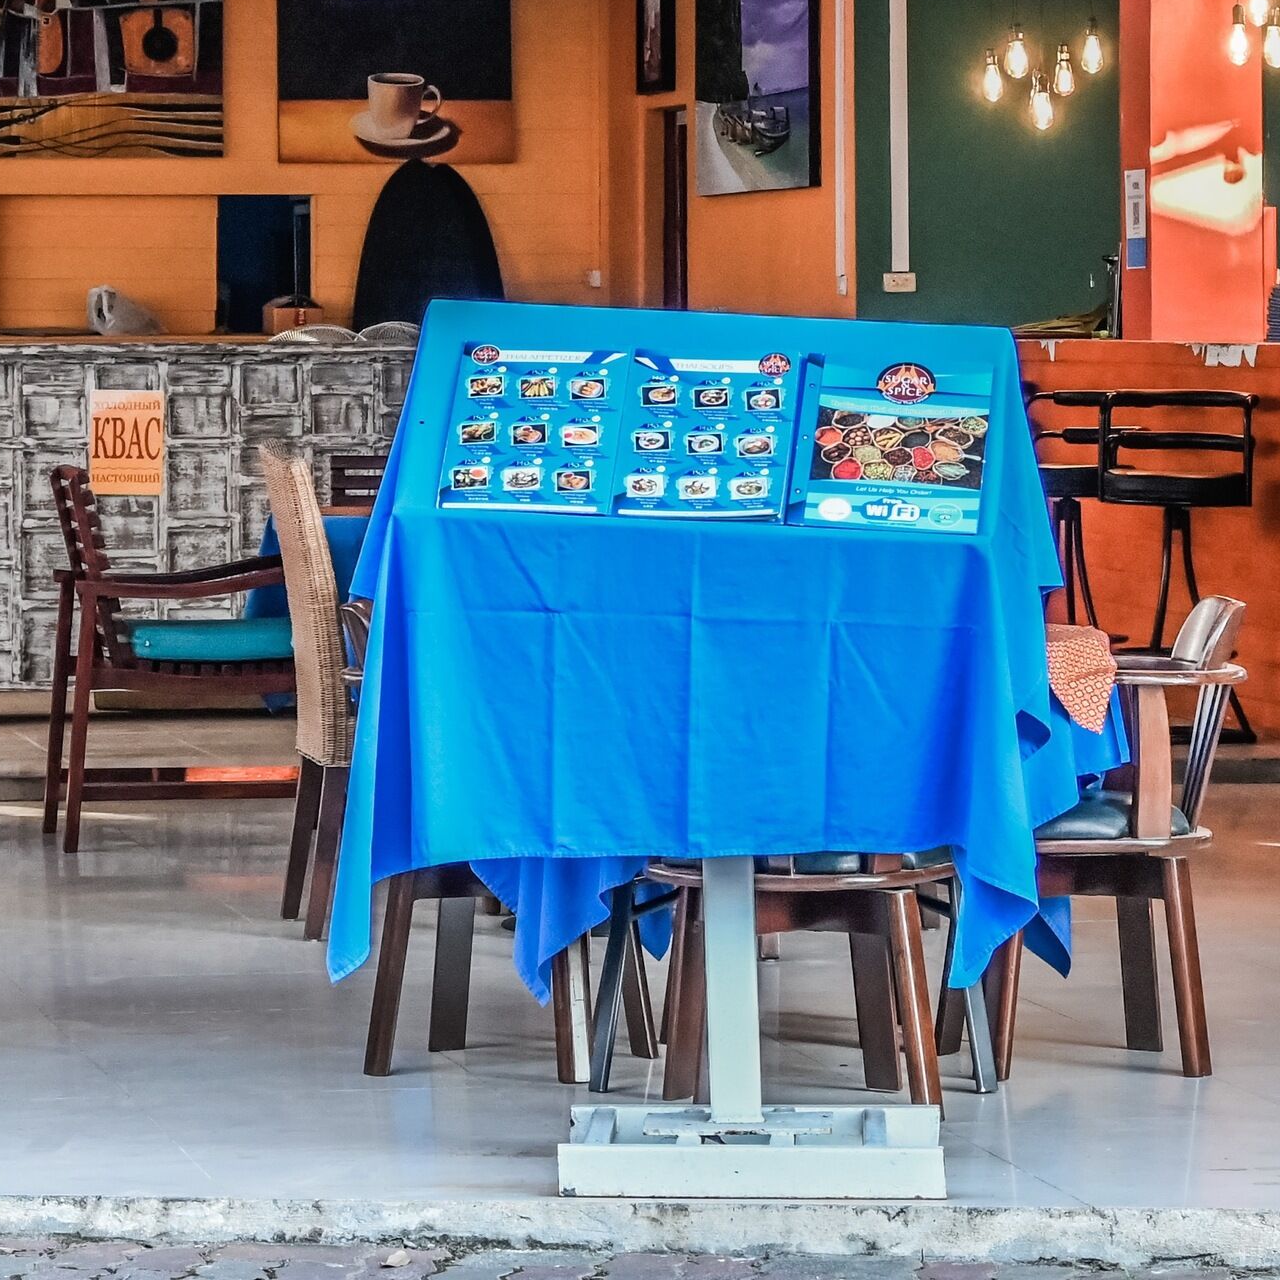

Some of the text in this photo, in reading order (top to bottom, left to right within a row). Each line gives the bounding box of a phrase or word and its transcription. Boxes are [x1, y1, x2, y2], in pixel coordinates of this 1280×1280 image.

[884, 374, 928, 385] SUGAR
[887, 387, 922, 397] SPICE
[92, 416, 160, 460] КВАС
[92, 473, 160, 483] НАСТОЯЩИЙ
